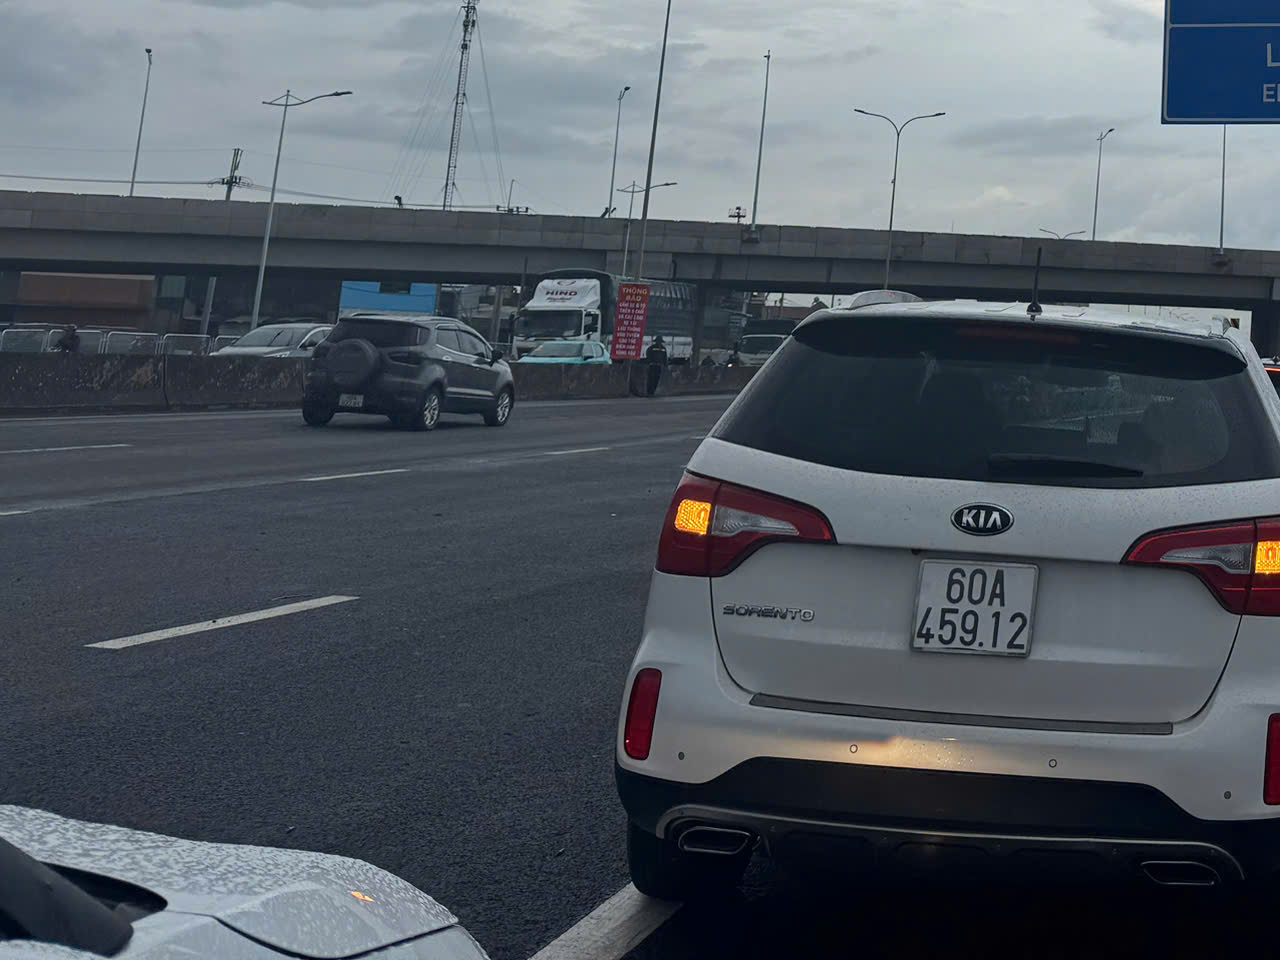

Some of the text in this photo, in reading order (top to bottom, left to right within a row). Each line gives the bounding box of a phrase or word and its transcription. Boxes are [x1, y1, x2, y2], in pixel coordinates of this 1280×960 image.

[961, 511, 1002, 530] KIA
[946, 568, 1006, 607] 60A
[722, 603, 816, 622] SORENTO
[916, 607, 1028, 650] 459.12
